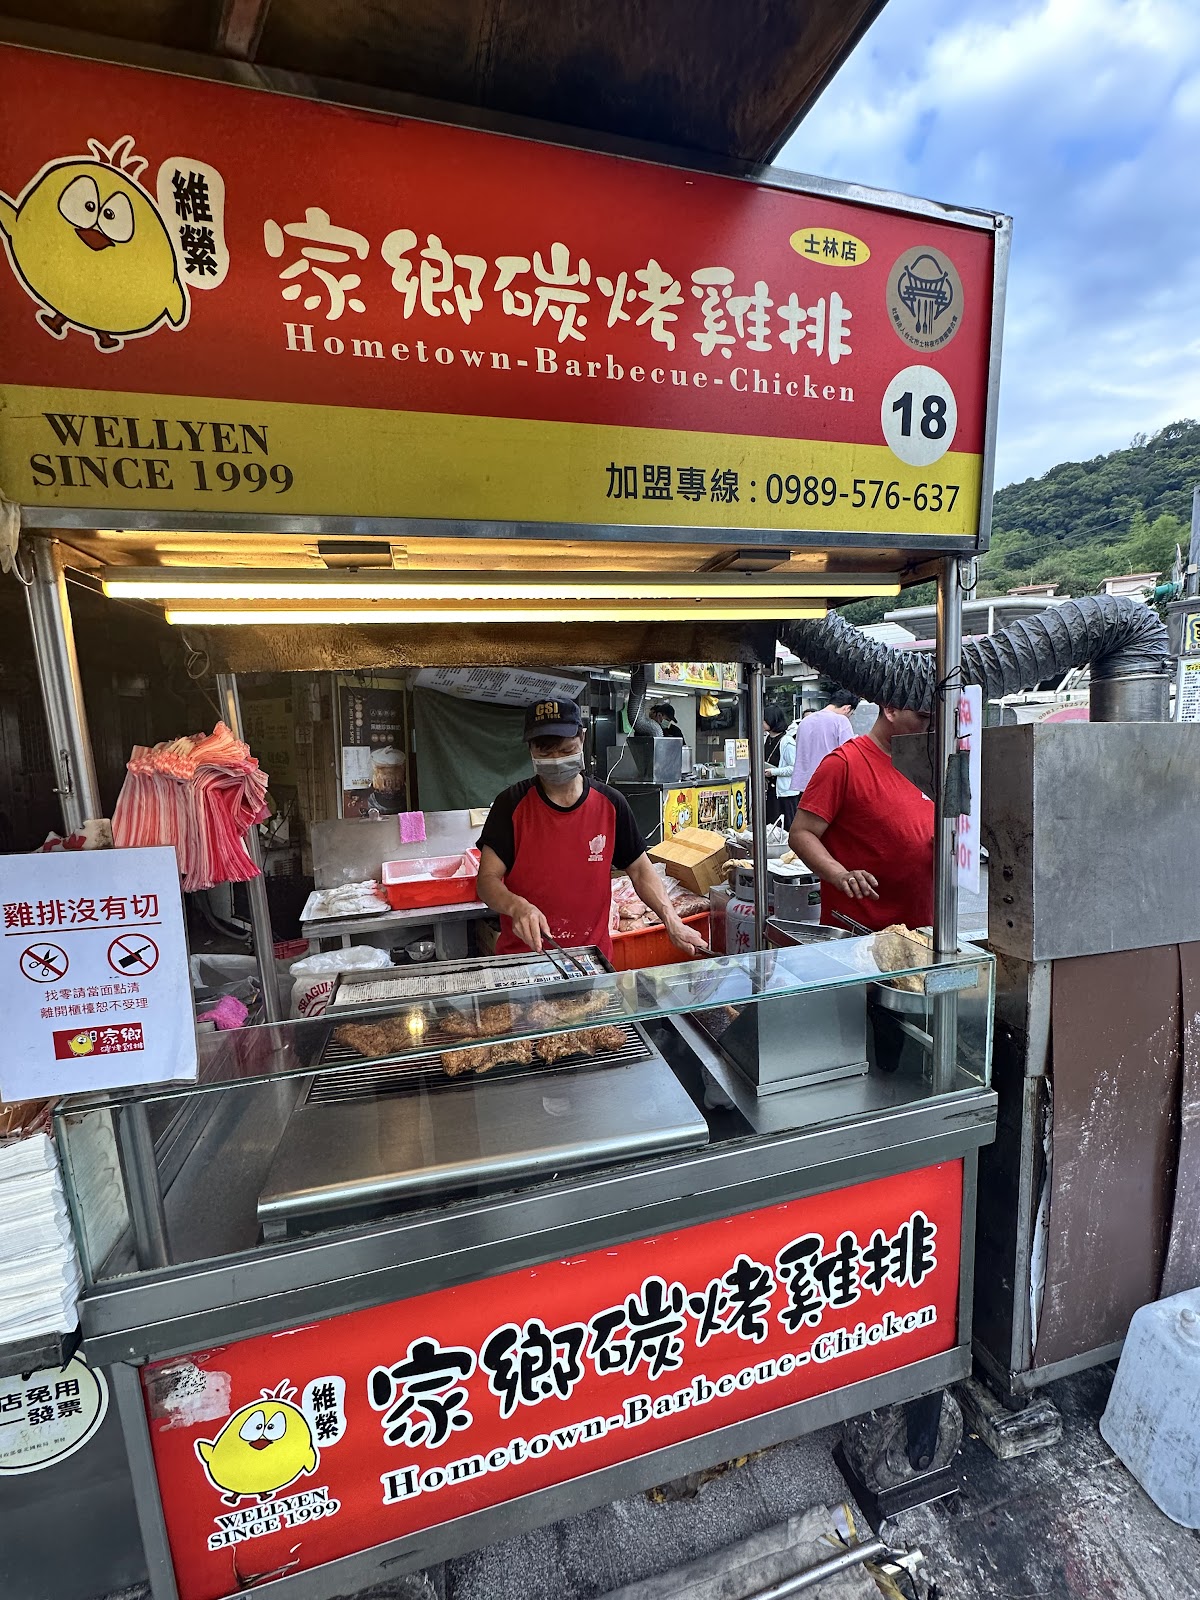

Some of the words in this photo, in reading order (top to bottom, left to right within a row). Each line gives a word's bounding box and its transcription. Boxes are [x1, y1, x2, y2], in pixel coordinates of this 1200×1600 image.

[803, 234, 858, 262] 士林店
[264, 207, 852, 365] 家鄉碳烤雞排
[283, 322, 855, 403] Hometown-Barbecue-Chicken
[42, 413, 269, 456] WELLYEN
[892, 391, 948, 440] 18
[29, 454, 175, 490] SINCE
[192, 460, 294, 494] 1999
[765, 473, 960, 513] 0989-576-637
[2, 894, 159, 928] 雞排沒有切
[40, 997, 149, 1019] 離開櫃檯恕不受理
[45, 981, 140, 1002] 找零請當面點清
[100, 1027, 142, 1045] 家鄉
[370, 1212, 938, 1446] 家鄉碳烤雞排
[383, 1304, 938, 1502] Hometown-Barbecue-Chicken
[209, 1520, 280, 1550] SINCE
[286, 1499, 340, 1528] 1999
[215, 1486, 330, 1531] WELLYEN
